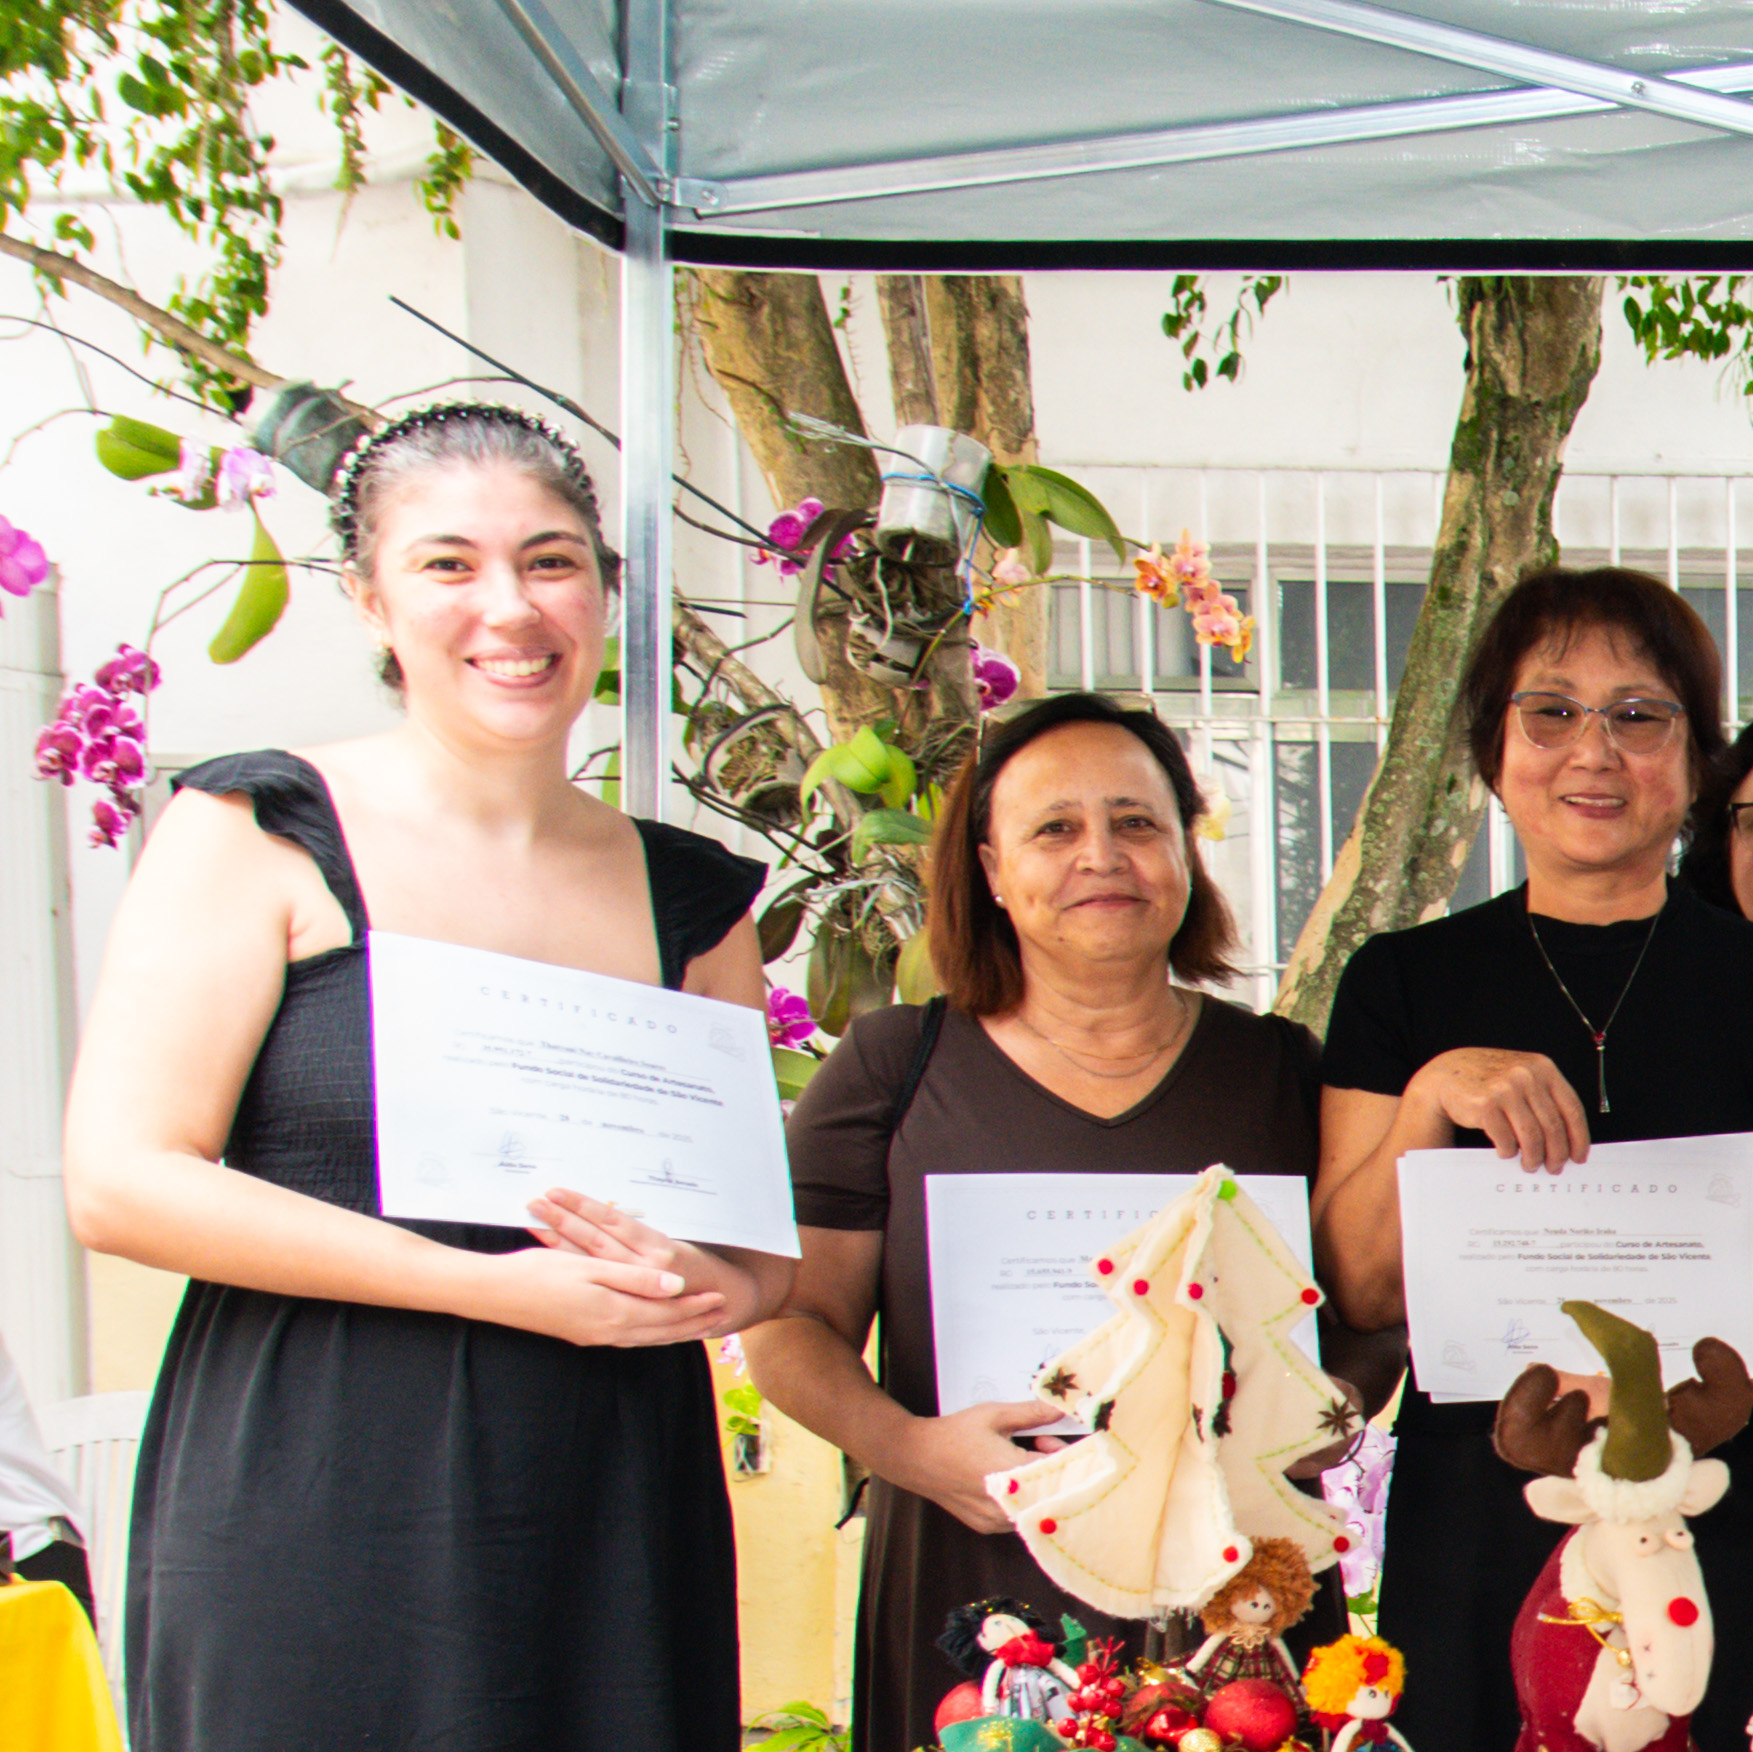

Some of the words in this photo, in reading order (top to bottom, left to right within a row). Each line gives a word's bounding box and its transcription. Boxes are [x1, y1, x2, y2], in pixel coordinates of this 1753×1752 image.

[480, 986, 677, 1034] CERTIFICADO
[1496, 1184, 1677, 1193] CERTIFICADO
[1027, 1210, 1160, 1220] CERTIFIC
[1661, 1252, 1677, 1260] São
